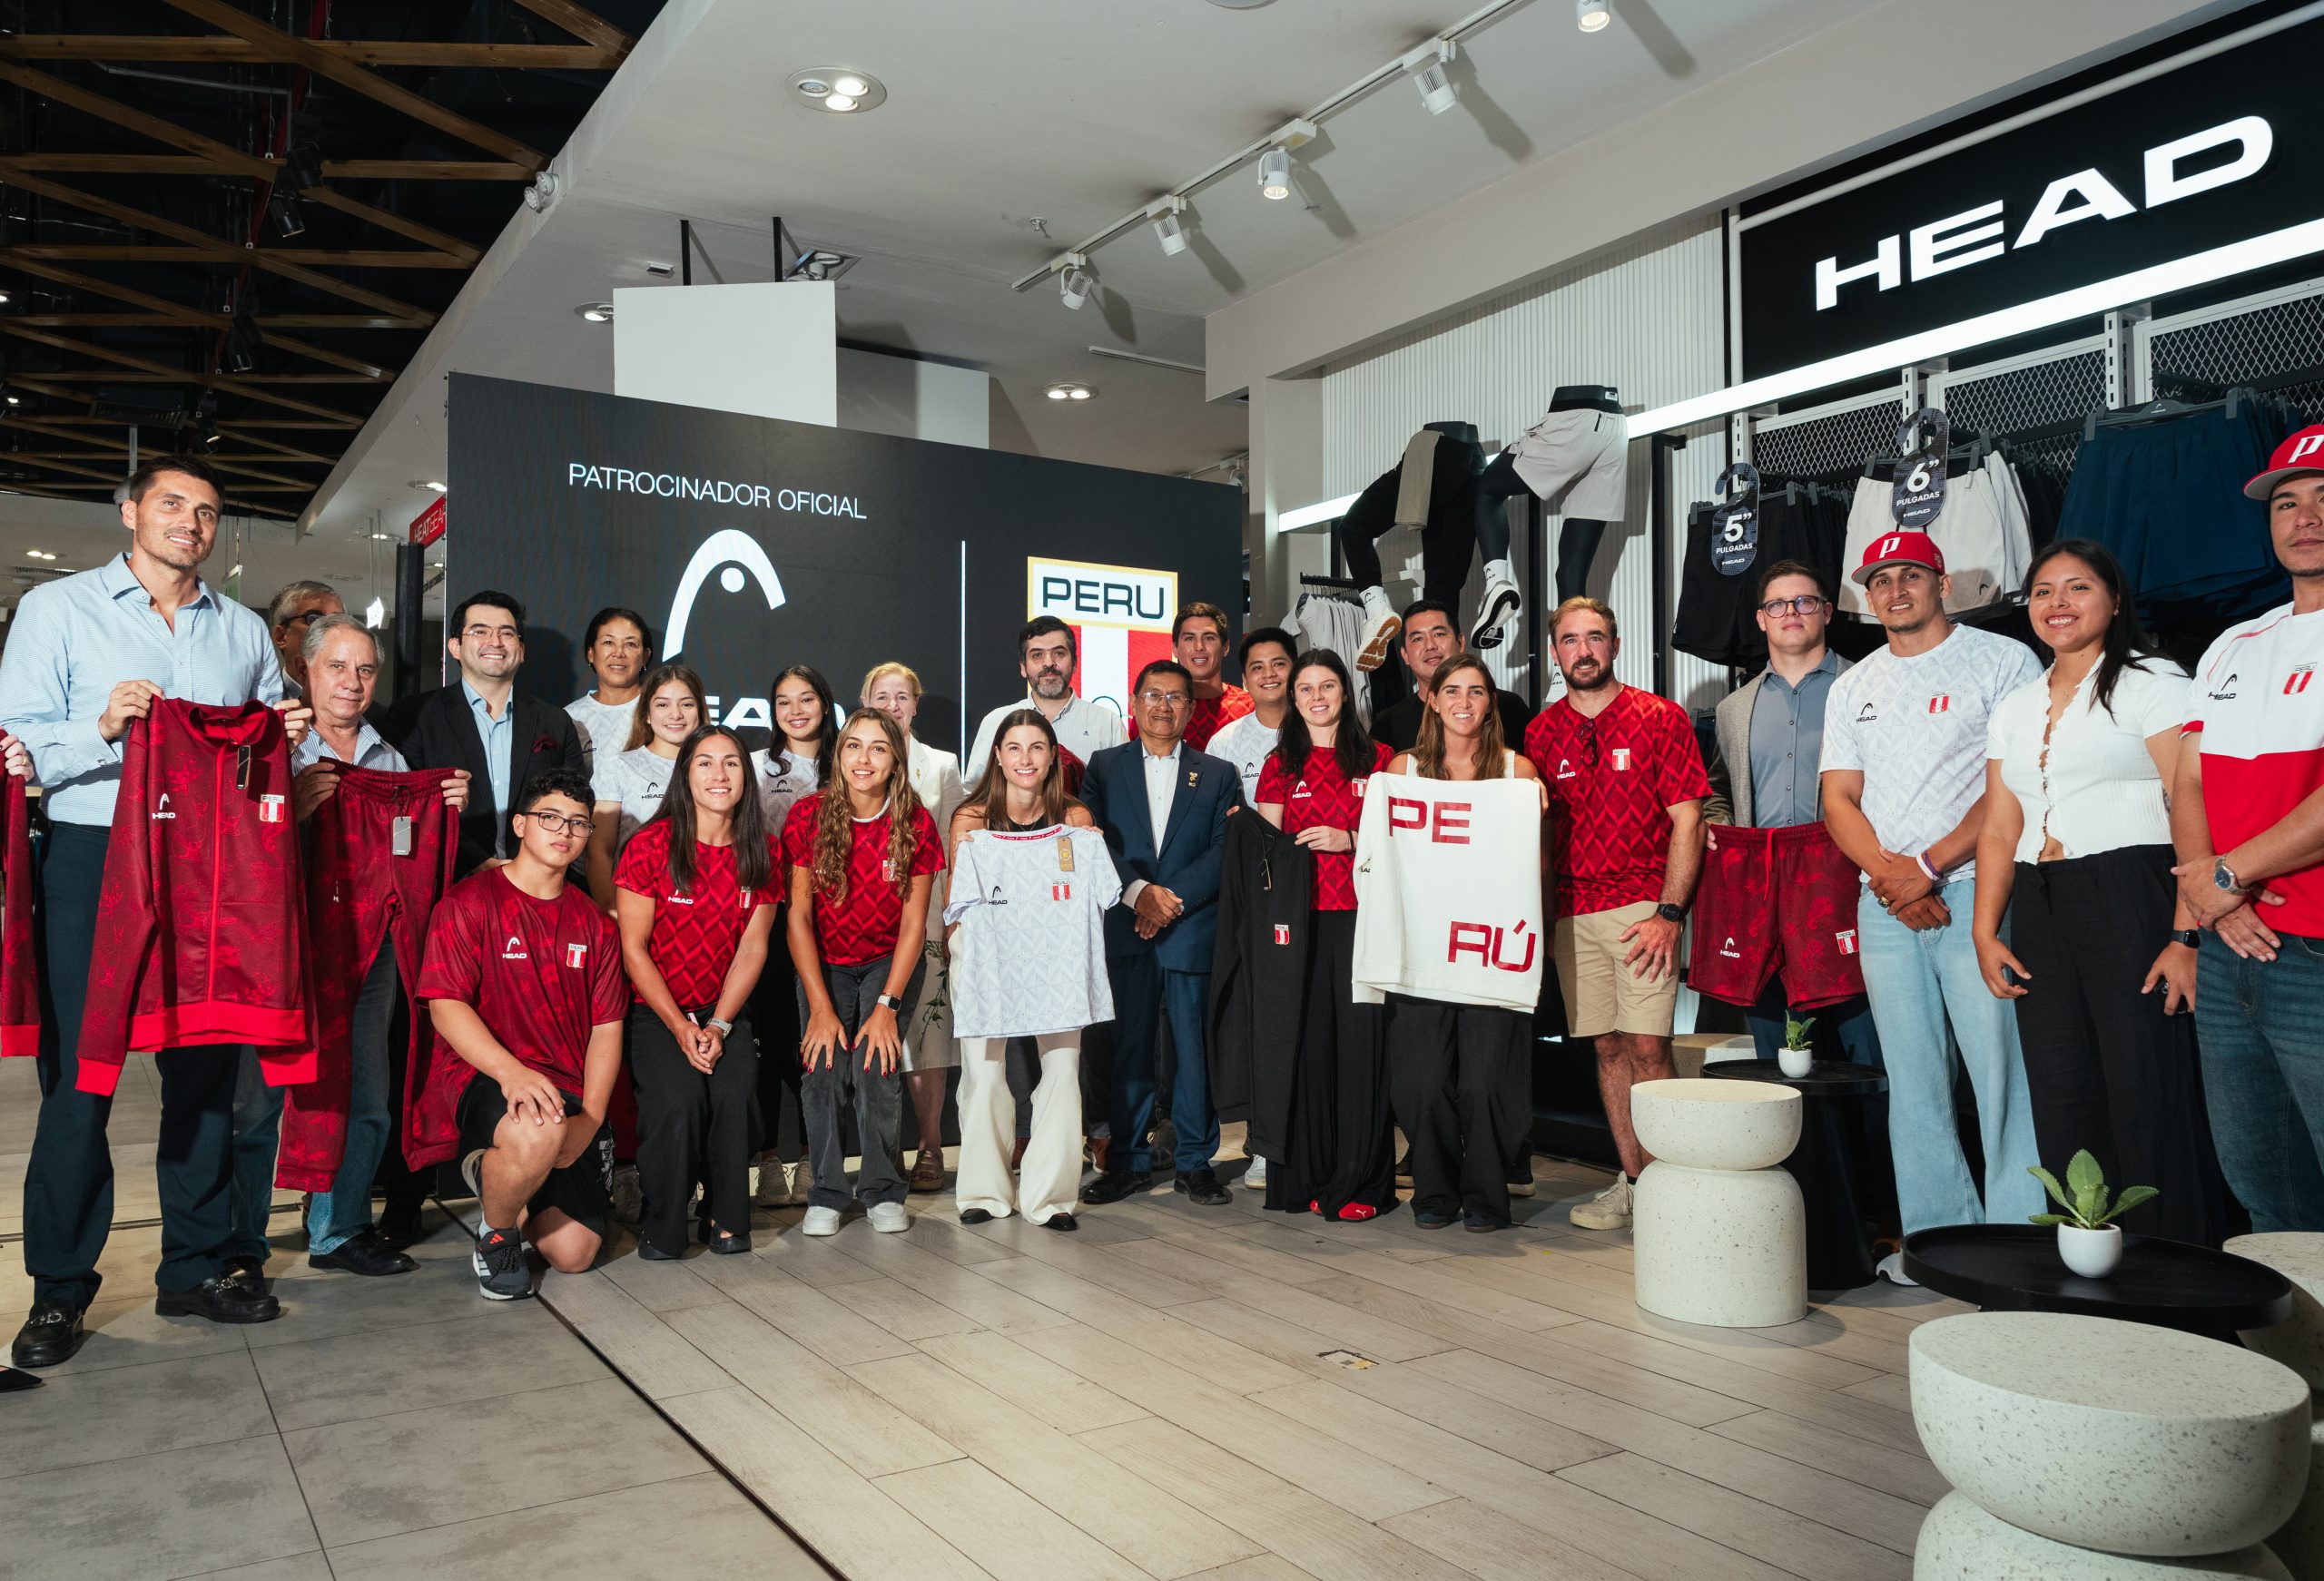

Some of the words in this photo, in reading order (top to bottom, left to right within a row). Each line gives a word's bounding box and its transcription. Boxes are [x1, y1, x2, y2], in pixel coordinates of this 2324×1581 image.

[1815, 115, 2273, 311] HEAD
[569, 463, 771, 508] PATROCINADOR
[778, 488, 867, 519] OFICIAL
[1896, 491, 1940, 506] PULGADAS
[1903, 508, 1931, 517] HEAD
[1716, 543, 1753, 555] PULGADAS
[1043, 576, 1164, 619] PERU
[2208, 692, 2236, 700] HEAD
[1557, 771, 1576, 780] HEAD
[1388, 795, 1472, 845] PE
[667, 896, 694, 905] HEAD
[1448, 918, 1536, 973] RÚ
[1719, 949, 1740, 958] HEAD
